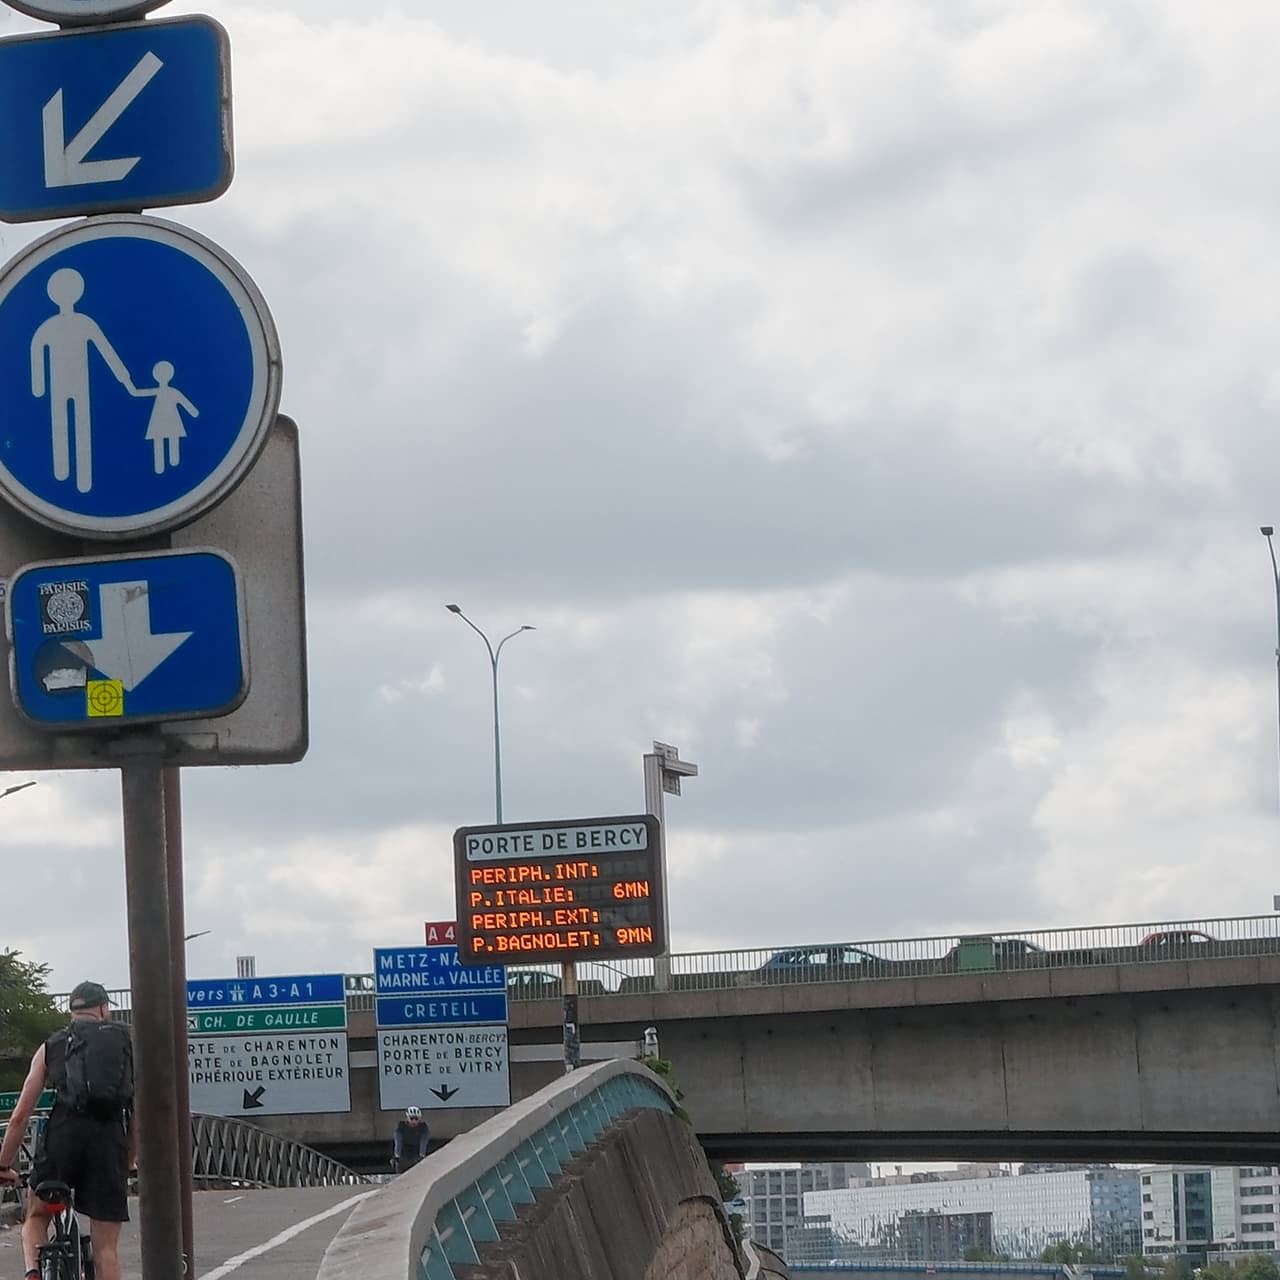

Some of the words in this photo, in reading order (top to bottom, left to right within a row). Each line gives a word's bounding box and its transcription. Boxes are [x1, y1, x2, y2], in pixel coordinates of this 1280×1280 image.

[467, 834, 534, 855] PORTE
[542, 832, 569, 850] DE
[576, 827, 645, 848] BERCY
[469, 887, 574, 907] P.ITALIE:
[613, 880, 650, 899] 6MN
[428, 926, 438, 941] A
[444, 926, 456, 940] 4
[472, 931, 601, 953] P.BAGNOLET:
[616, 926, 653, 945] 9MN
[380, 952, 463, 969] METZ-NA
[379, 972, 430, 988] MARNE
[433, 977, 445, 986] LA
[449, 966, 502, 985] VALLÉE
[187, 989, 224, 1001] vers
[403, 1001, 479, 1018] CRETEIL
[204, 1016, 227, 1029] CH.
[236, 1014, 254, 1027] DE
[264, 1011, 319, 1026] GAULLE
[187, 1043, 216, 1055] RTE
[244, 1038, 339, 1052] CHARENTON
[383, 1049, 430, 1061] PORTE
[436, 1051, 449, 1060] DE
[455, 1046, 502, 1059] BERCY
[194, 1057, 222, 1069] RTE
[251, 1053, 333, 1067] BAGNOLET
[384, 1063, 432, 1076] PORTE
[439, 1066, 452, 1074] DE
[459, 1061, 503, 1073] VITRY
[191, 1068, 263, 1083] IPHÉRIQUE
[269, 1066, 344, 1081] EXTÉRIEUR
